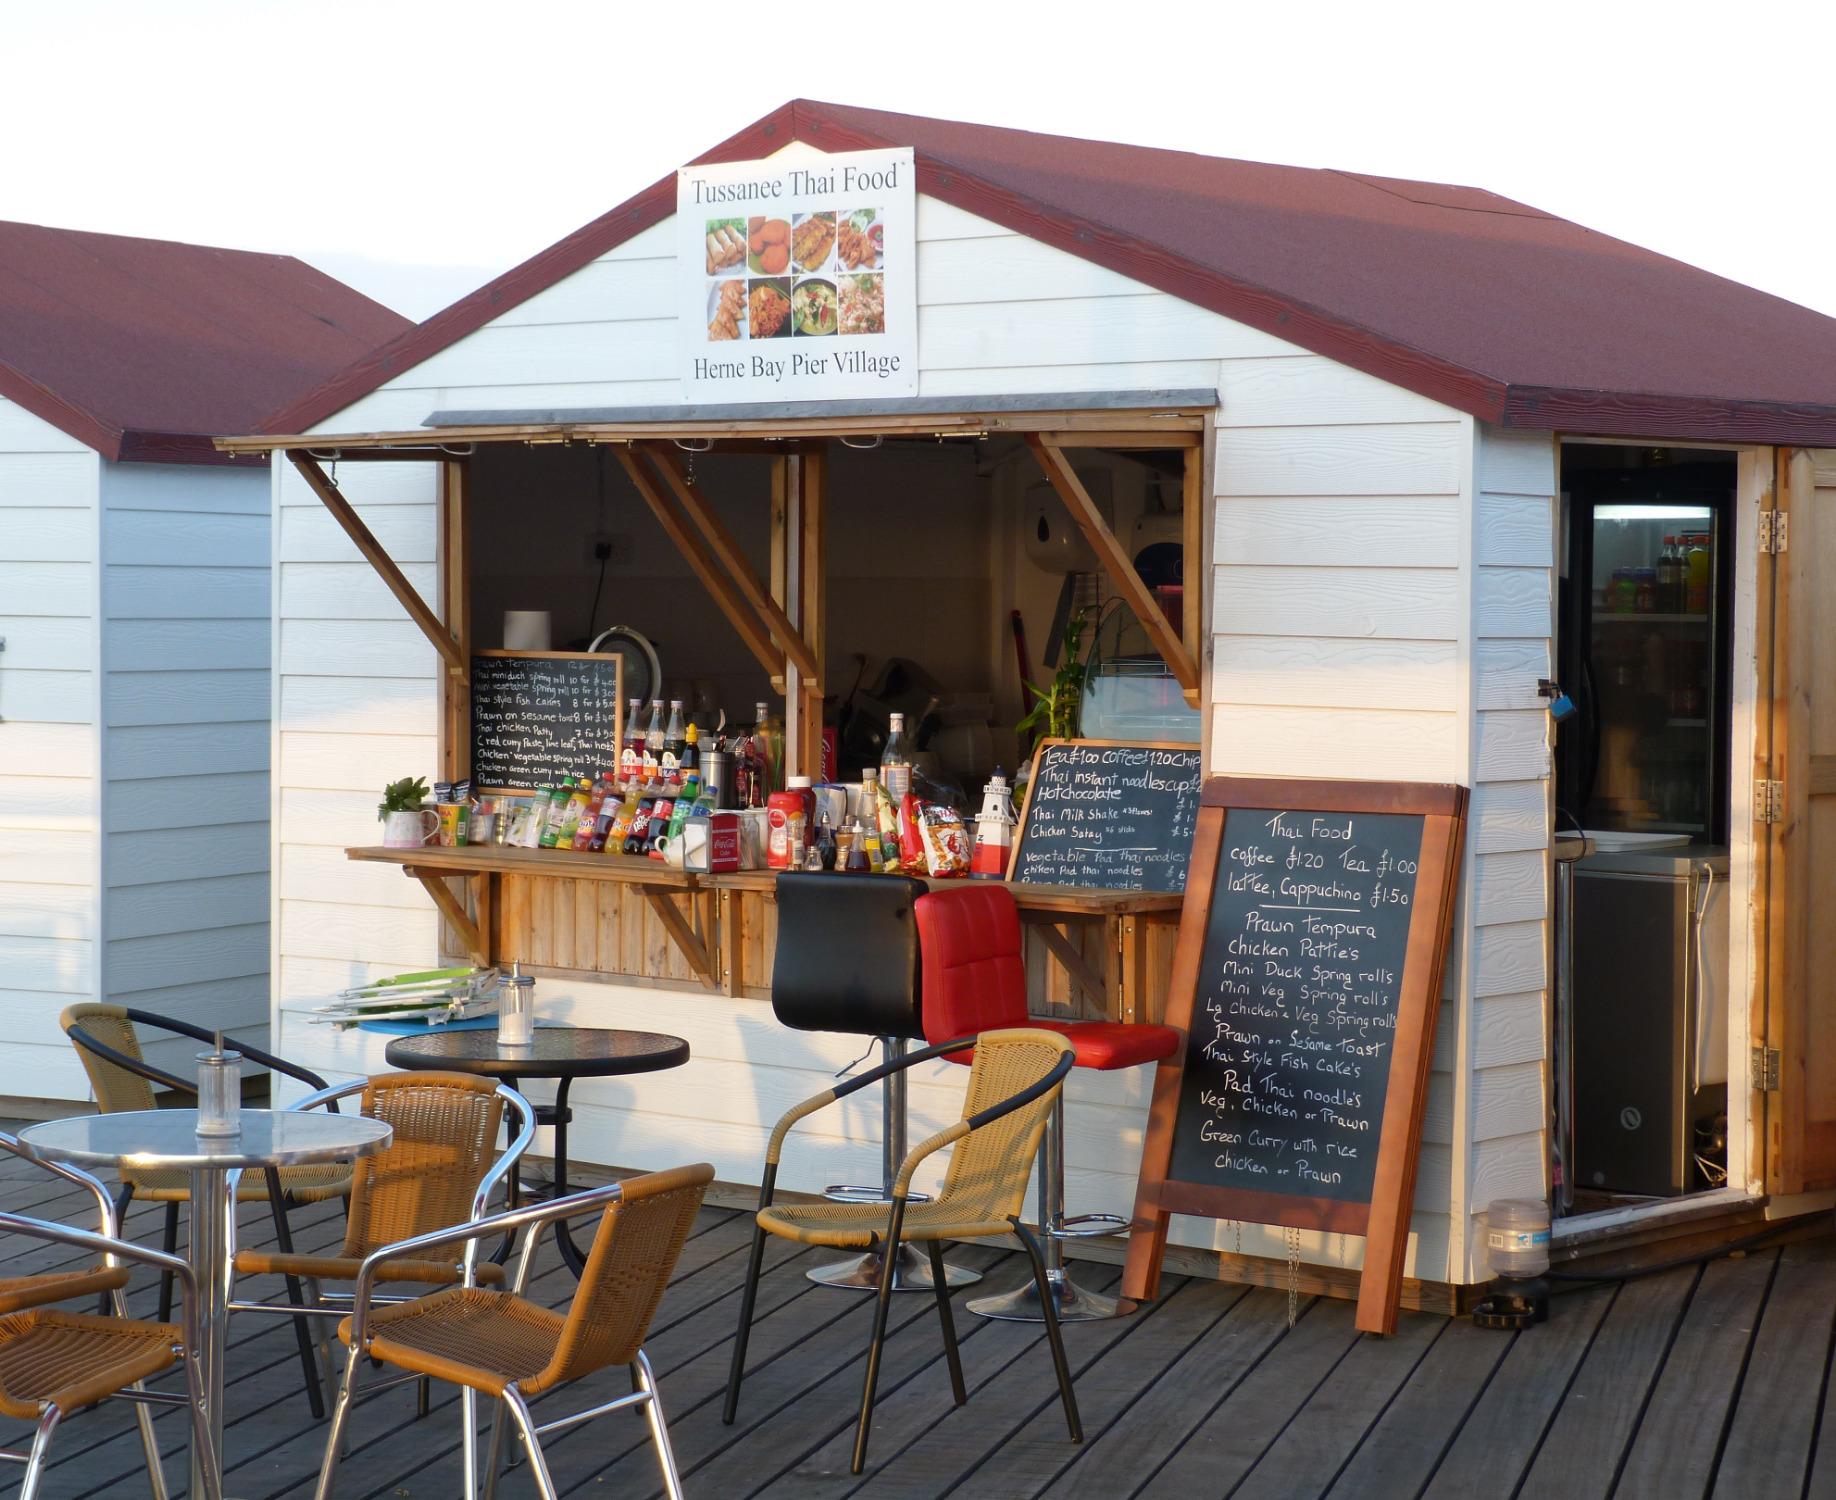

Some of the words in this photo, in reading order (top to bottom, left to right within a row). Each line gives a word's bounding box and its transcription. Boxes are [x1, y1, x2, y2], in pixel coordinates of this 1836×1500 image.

[692, 179, 782, 204] Tussanee
[788, 168, 834, 197] Thai
[842, 162, 899, 192] Food
[694, 356, 746, 380] Herne
[751, 355, 786, 382] Bay
[792, 353, 828, 376] Pier
[833, 351, 901, 378] Village
[507, 670, 526, 680] duck
[529, 672, 551, 687] spring
[532, 684, 556, 700] spring
[475, 705, 503, 721] Prawn
[505, 711, 518, 721] on
[521, 711, 556, 722] sesame
[502, 740, 522, 753] curry
[578, 739, 593, 749] Thai
[1041, 745, 1070, 766] Tea
[514, 752, 552, 765] vegetable
[553, 754, 574, 769] spring
[554, 767, 570, 777] with
[478, 772, 504, 785] Prawn
[1041, 764, 1070, 783] Thai
[1074, 770, 1119, 786] instant
[1122, 769, 1167, 790] noodles
[1037, 783, 1063, 801] Hot
[1032, 805, 1055, 821] Thai
[1087, 807, 1119, 821] Shake
[1030, 823, 1066, 838] Chicken
[1070, 826, 1103, 844] Satay
[1265, 811, 1303, 839] Thai
[1311, 818, 1353, 840] Food
[1094, 851, 1113, 863] Pad
[1145, 848, 1185, 863] noodles
[1285, 845, 1324, 870] £1.20
[1338, 845, 1371, 873] Tea
[1376, 848, 1417, 879] £1.00
[1059, 864, 1078, 876] Pad
[1082, 864, 1101, 875] thai
[1106, 865, 1143, 876] noodles
[1279, 876, 1362, 905] Cappuchino
[1369, 882, 1409, 909] £1.50
[1245, 910, 1295, 933] Prawn
[1223, 960, 1254, 975] Mini
[1264, 961, 1303, 979] Duck
[1311, 965, 1353, 991] Spring
[1220, 980, 1250, 995] Mini
[1261, 981, 1286, 1008] Veg
[1300, 984, 1347, 1014] Spring
[1206, 996, 1223, 1023] Lg
[1295, 1005, 1320, 1034] Veg
[1326, 1010, 1370, 1038] Spring
[1215, 1022, 1260, 1046] Prawn
[1288, 1029, 1332, 1052] Sesame
[1202, 1039, 1235, 1063] Thai
[1240, 1049, 1273, 1073] Style
[1280, 1052, 1309, 1071] Fish
[1223, 1069, 1254, 1094] Pad
[1259, 1072, 1295, 1099] Thai
[1305, 1112, 1318, 1120] or
[1320, 1107, 1369, 1131] Prawn
[1200, 1119, 1242, 1144] Green
[1248, 1129, 1289, 1158] Curry
[1293, 1138, 1318, 1153] with
[1326, 1141, 1358, 1158] rice
[1276, 1168, 1290, 1176] or
[1295, 1158, 1341, 1184] Prawn
